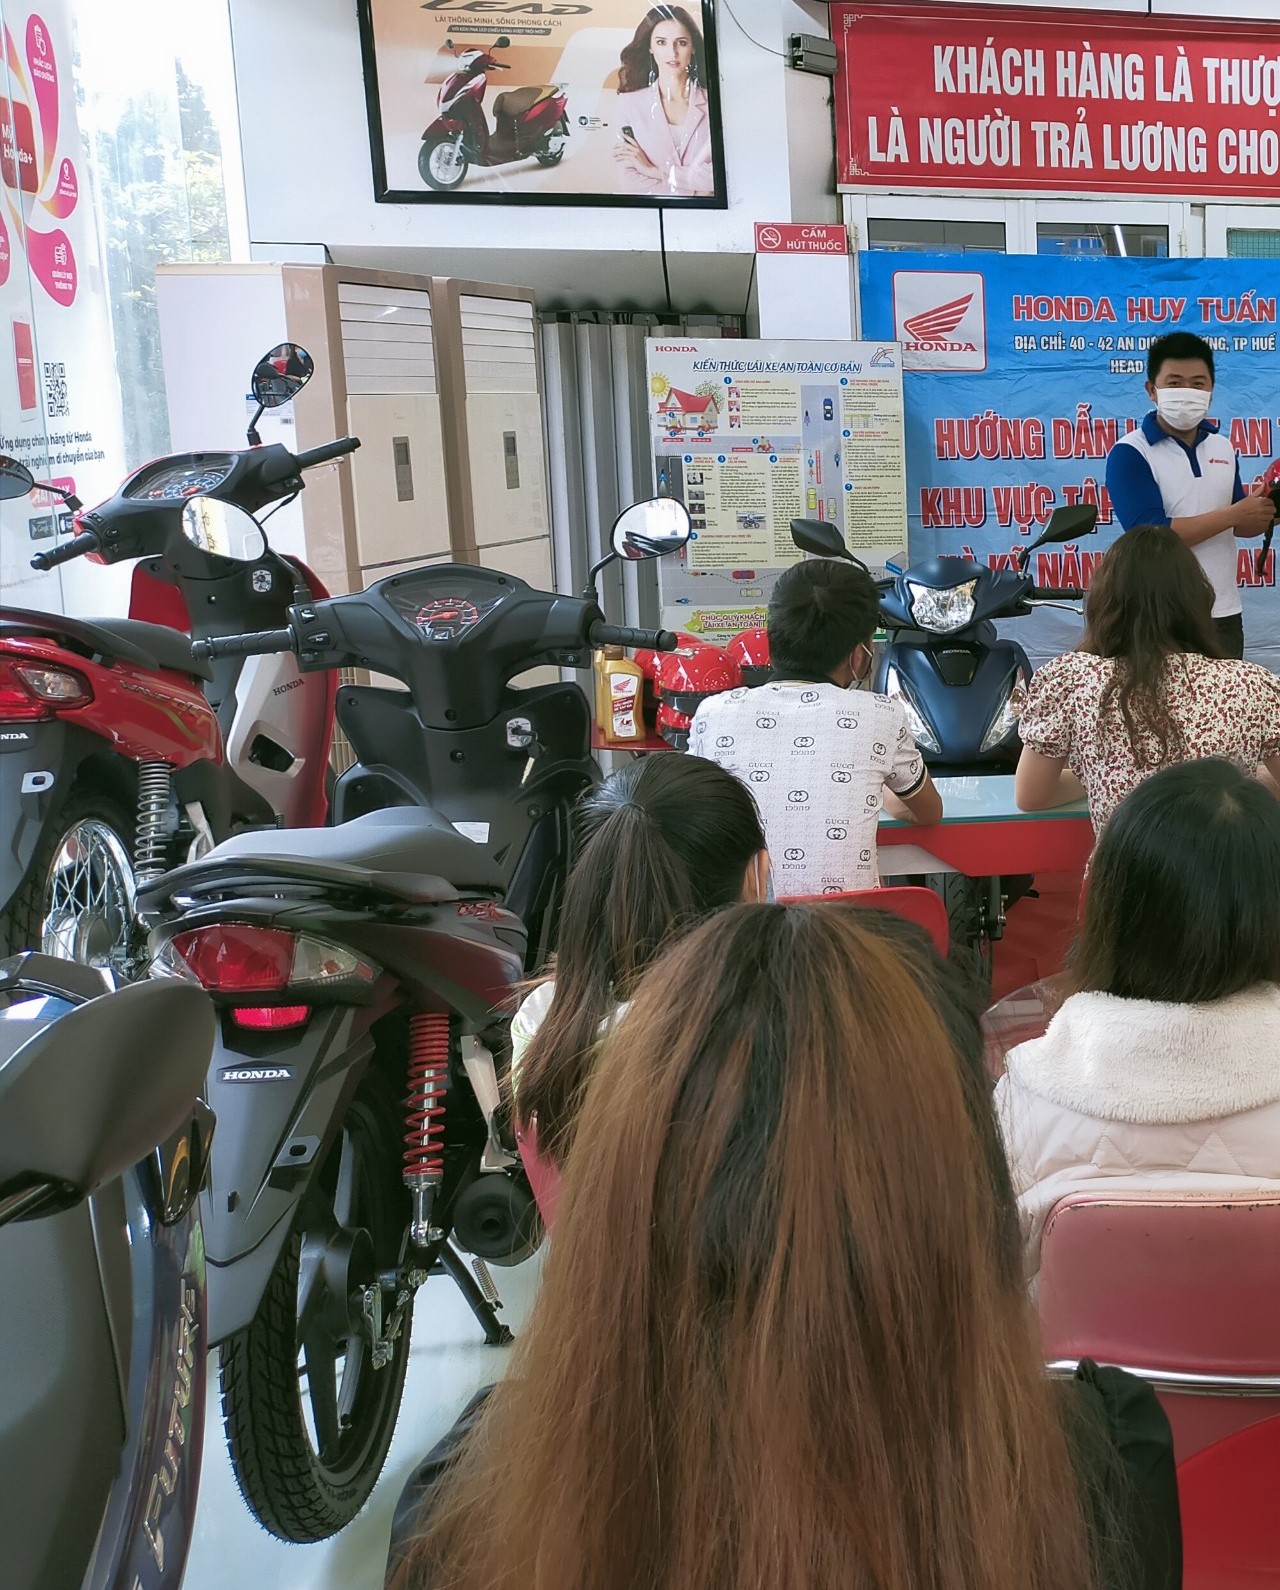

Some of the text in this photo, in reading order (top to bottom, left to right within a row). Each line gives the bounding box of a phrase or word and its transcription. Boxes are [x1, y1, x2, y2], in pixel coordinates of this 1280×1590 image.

[419, 0, 593, 15] LEAD
[435, 15, 562, 27] LÁI THÔNG MINH, SỐNG PHONG CÁCH
[933, 37, 1045, 96] KHÁCH
[1055, 41, 1144, 100] HÀNG
[1155, 46, 1193, 102] LÀ
[868, 106, 910, 164] LÀ
[918, 108, 1021, 167] NGƯỜI
[1031, 106, 1093, 169] TRẢ
[1103, 120, 1206, 173] LƯƠNG
[1217, 128, 1279, 176] CHO
[4, 143, 33, 164] Hoda+
[801, 226, 827, 238] CẤM
[786, 238, 842, 250] HÚT THUỐC
[1013, 288, 1277, 324] HONDA HUY TUẤN
[905, 342, 978, 352] HONDA
[1014, 336, 1037, 353] ĐỊA
[1040, 331, 1066, 351] CHỈ:
[1069, 336, 1086, 351] 40
[1098, 336, 1114, 351] 42
[1116, 336, 1135, 351] AN
[1233, 336, 1248, 351] TP
[1251, 332, 1276, 352] HUẾ
[692, 357, 717, 371] KIẾN
[719, 358, 744, 372] THỨC
[747, 358, 762, 372] LÁI
[765, 362, 778, 372] XE
[779, 362, 796, 373] AN
[798, 360, 822, 374] TOÀN
[824, 362, 839, 374] CƠ
[1110, 360, 1144, 374] HEAD
[934, 410, 1045, 460] HƯỚNG
[1052, 402, 1119, 459] DẪN
[1229, 416, 1273, 458] AN
[14, 436, 32, 452] dụng
[74, 430, 92, 442] Honda
[920, 486, 986, 528] KHU
[992, 482, 1055, 535] VỰC
[1036, 544, 1104, 590] NĂN
[1236, 547, 1275, 587] AN
[272, 678, 305, 696] HONDA
[0, 732, 30, 740] NDA
[830, 762, 855, 770] GUCCI
[222, 1069, 292, 1080] HONDA
[144, 1278, 200, 1573] FUTURE
